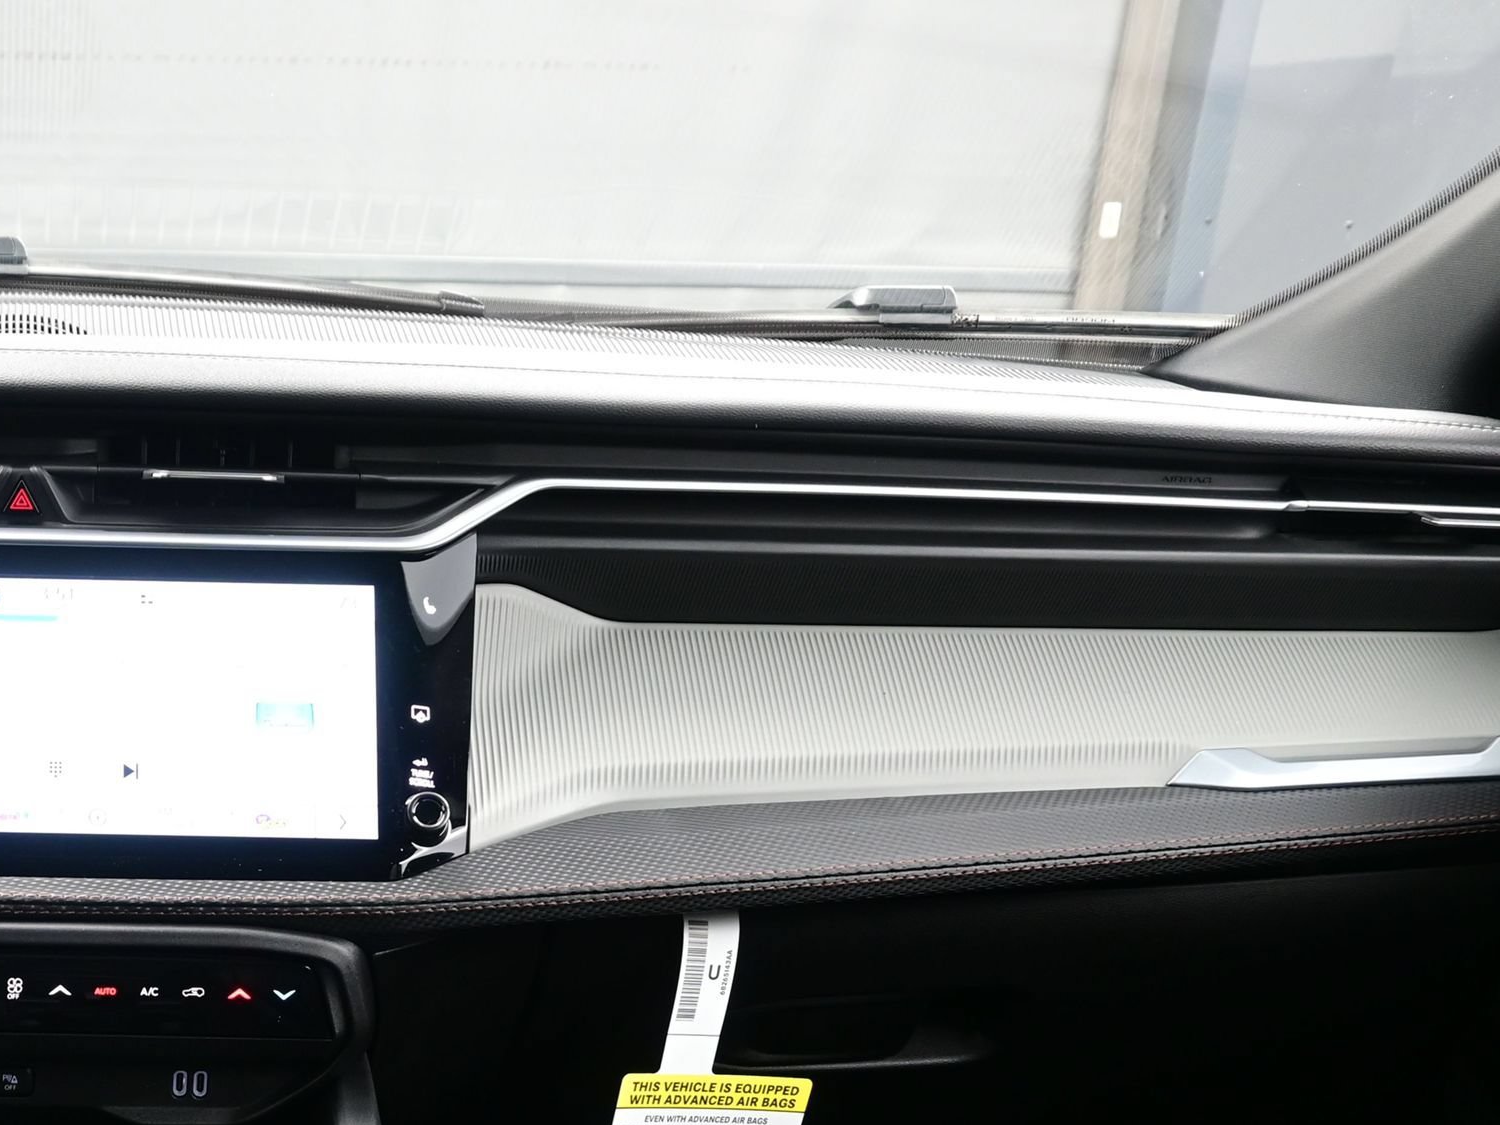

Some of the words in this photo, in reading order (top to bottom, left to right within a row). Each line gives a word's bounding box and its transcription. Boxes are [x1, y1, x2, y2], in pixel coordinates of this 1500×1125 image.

[94, 987, 117, 996] AUTO
[140, 987, 159, 997] A/C
[633, 1082, 661, 1092] THIS
[664, 1082, 717, 1093] VEHICLE
[720, 1083, 732, 1093] IS
[735, 1083, 800, 1096] EQUIPPED
[630, 1095, 661, 1105] WITH
[664, 1095, 734, 1106] ADVANCED
[736, 1097, 759, 1107] AIR
[761, 1098, 797, 1109] BAGS
[644, 1115, 665, 1123] EVEN
[667, 1115, 687, 1123] WITH
[687, 1115, 730, 1124] ADVANCED
[746, 1117, 768, 1125] BAGS
